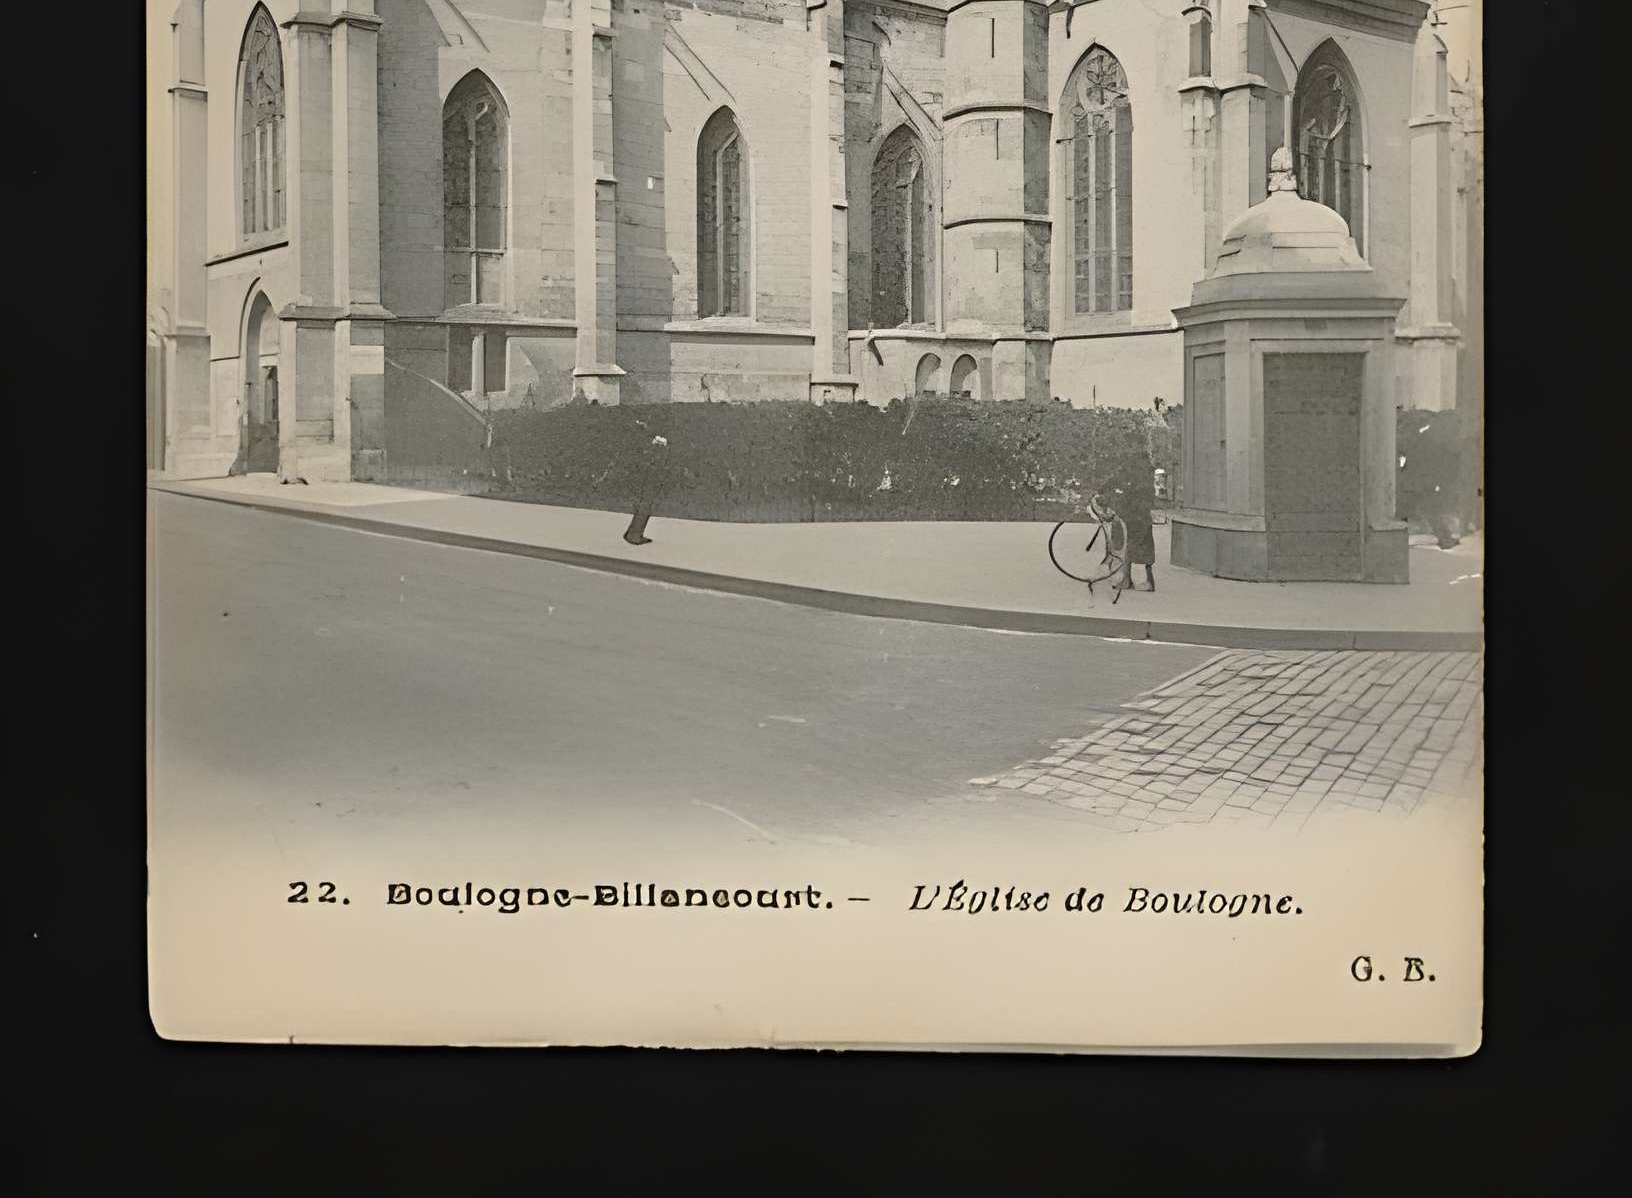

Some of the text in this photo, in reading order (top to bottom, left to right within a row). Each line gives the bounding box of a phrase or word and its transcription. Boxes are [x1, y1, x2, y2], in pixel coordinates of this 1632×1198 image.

[286, 881, 351, 907] 22.
[1123, 887, 1304, 918] Boulogne.
[1350, 955, 1436, 982] G. B.
